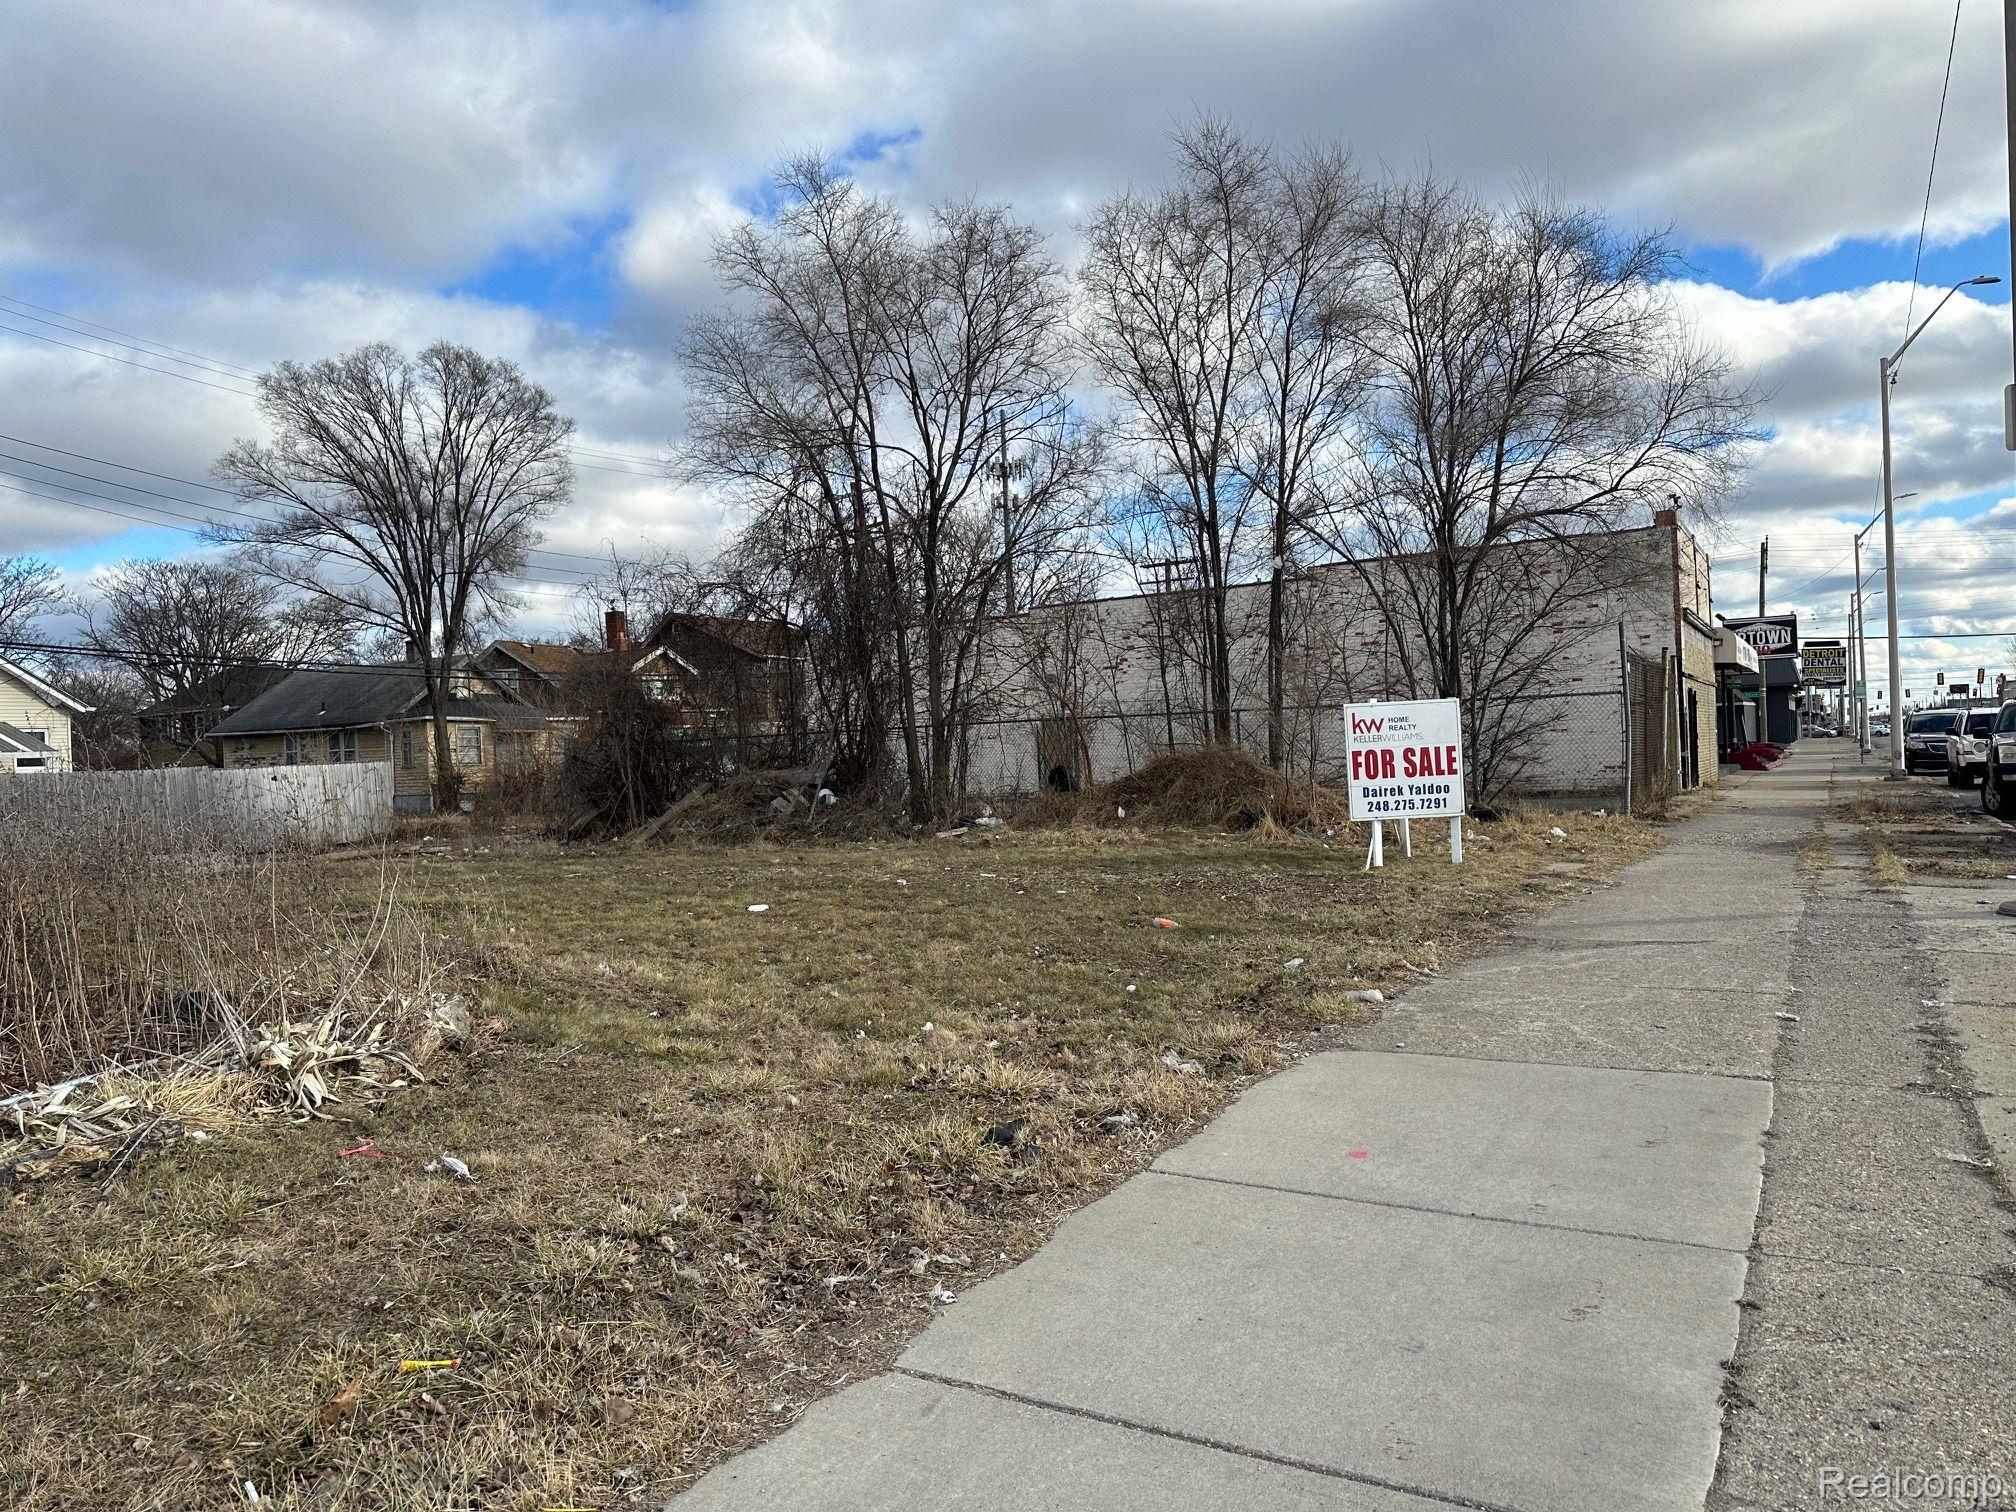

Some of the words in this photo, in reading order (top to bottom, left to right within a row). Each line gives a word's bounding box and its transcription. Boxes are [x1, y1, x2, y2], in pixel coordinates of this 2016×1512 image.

[1738, 629, 1791, 645] PTOWN
[1803, 649, 1844, 657] DETROIT
[1804, 657, 1843, 666] DENTAL
[1388, 716, 1409, 724] HOME
[1388, 724, 1417, 732] REALTY
[1351, 749, 1396, 780] FOR
[1403, 745, 1458, 778] SALE
[1362, 785, 1404, 798] Dairek
[1407, 783, 1450, 796] Yaldoo
[1367, 797, 1447, 812] 248.275.7291
